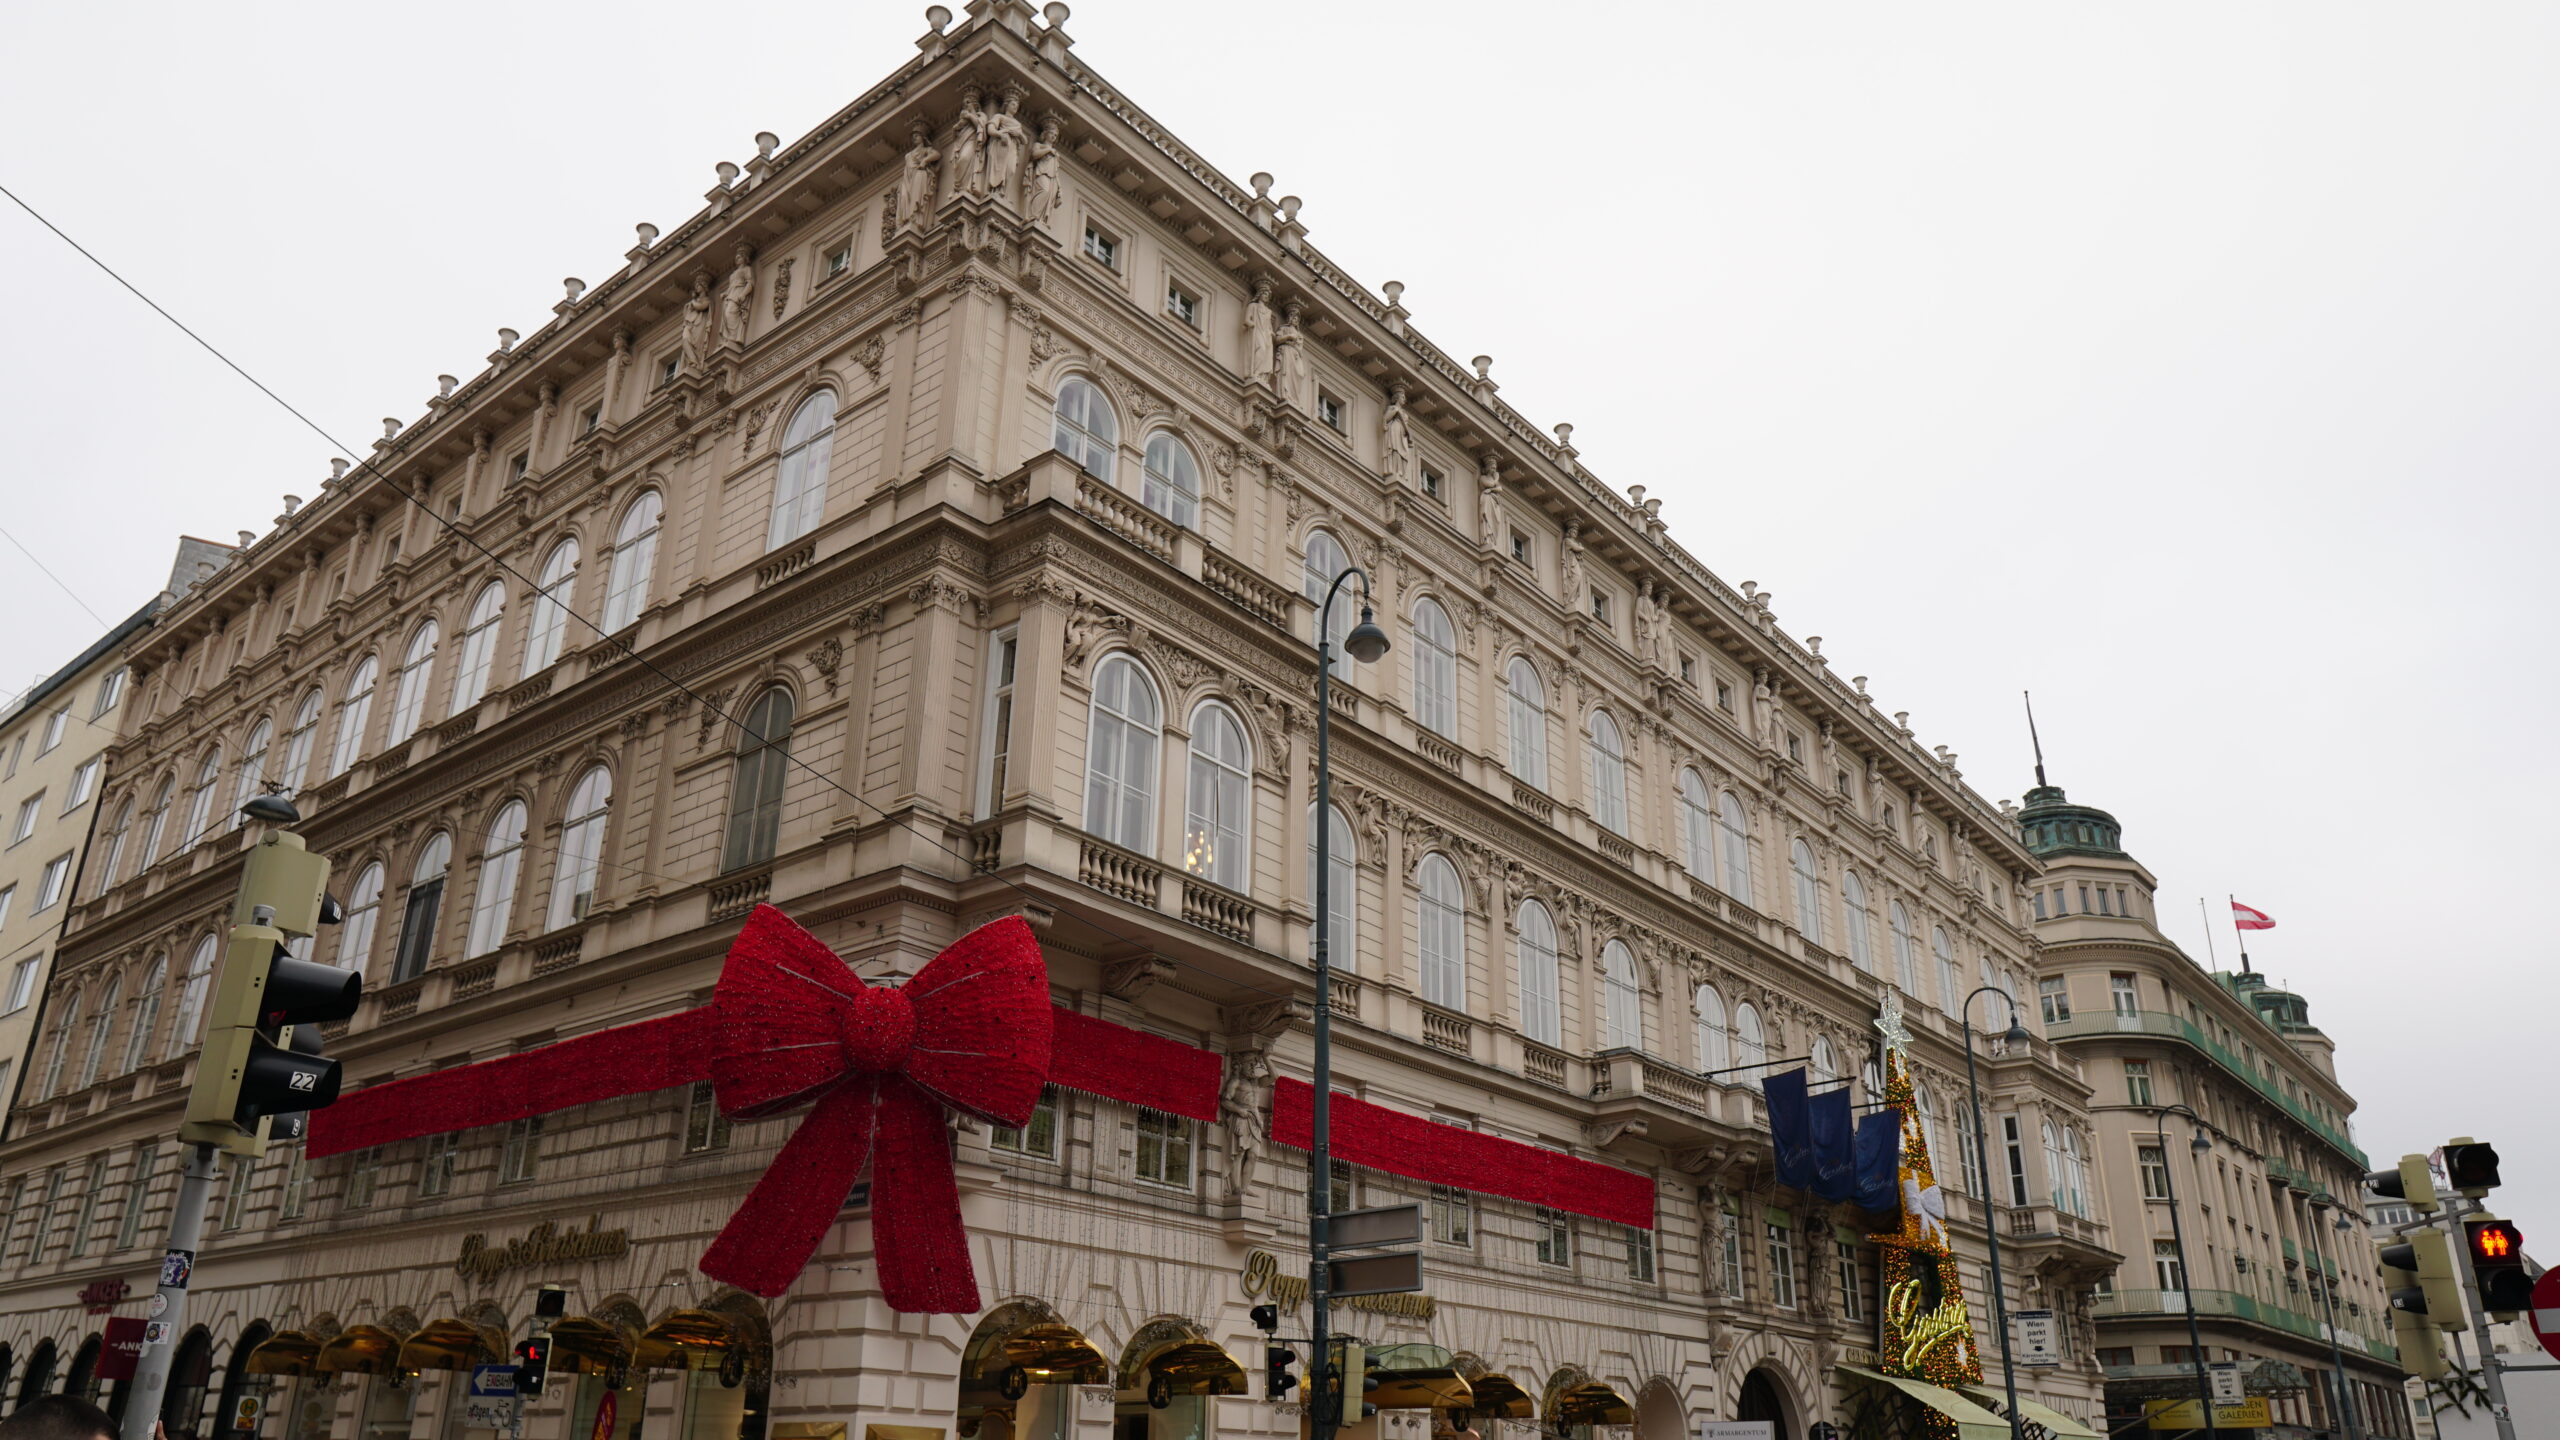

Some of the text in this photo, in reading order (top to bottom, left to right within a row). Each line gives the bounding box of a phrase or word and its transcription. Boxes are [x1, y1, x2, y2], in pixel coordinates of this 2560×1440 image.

[291, 1072, 315, 1090] 22
[2027, 1329, 2046, 1338] parkt
[118, 1341, 142, 1351] ANK
[2218, 1410, 2264, 1420] GALERIEN
